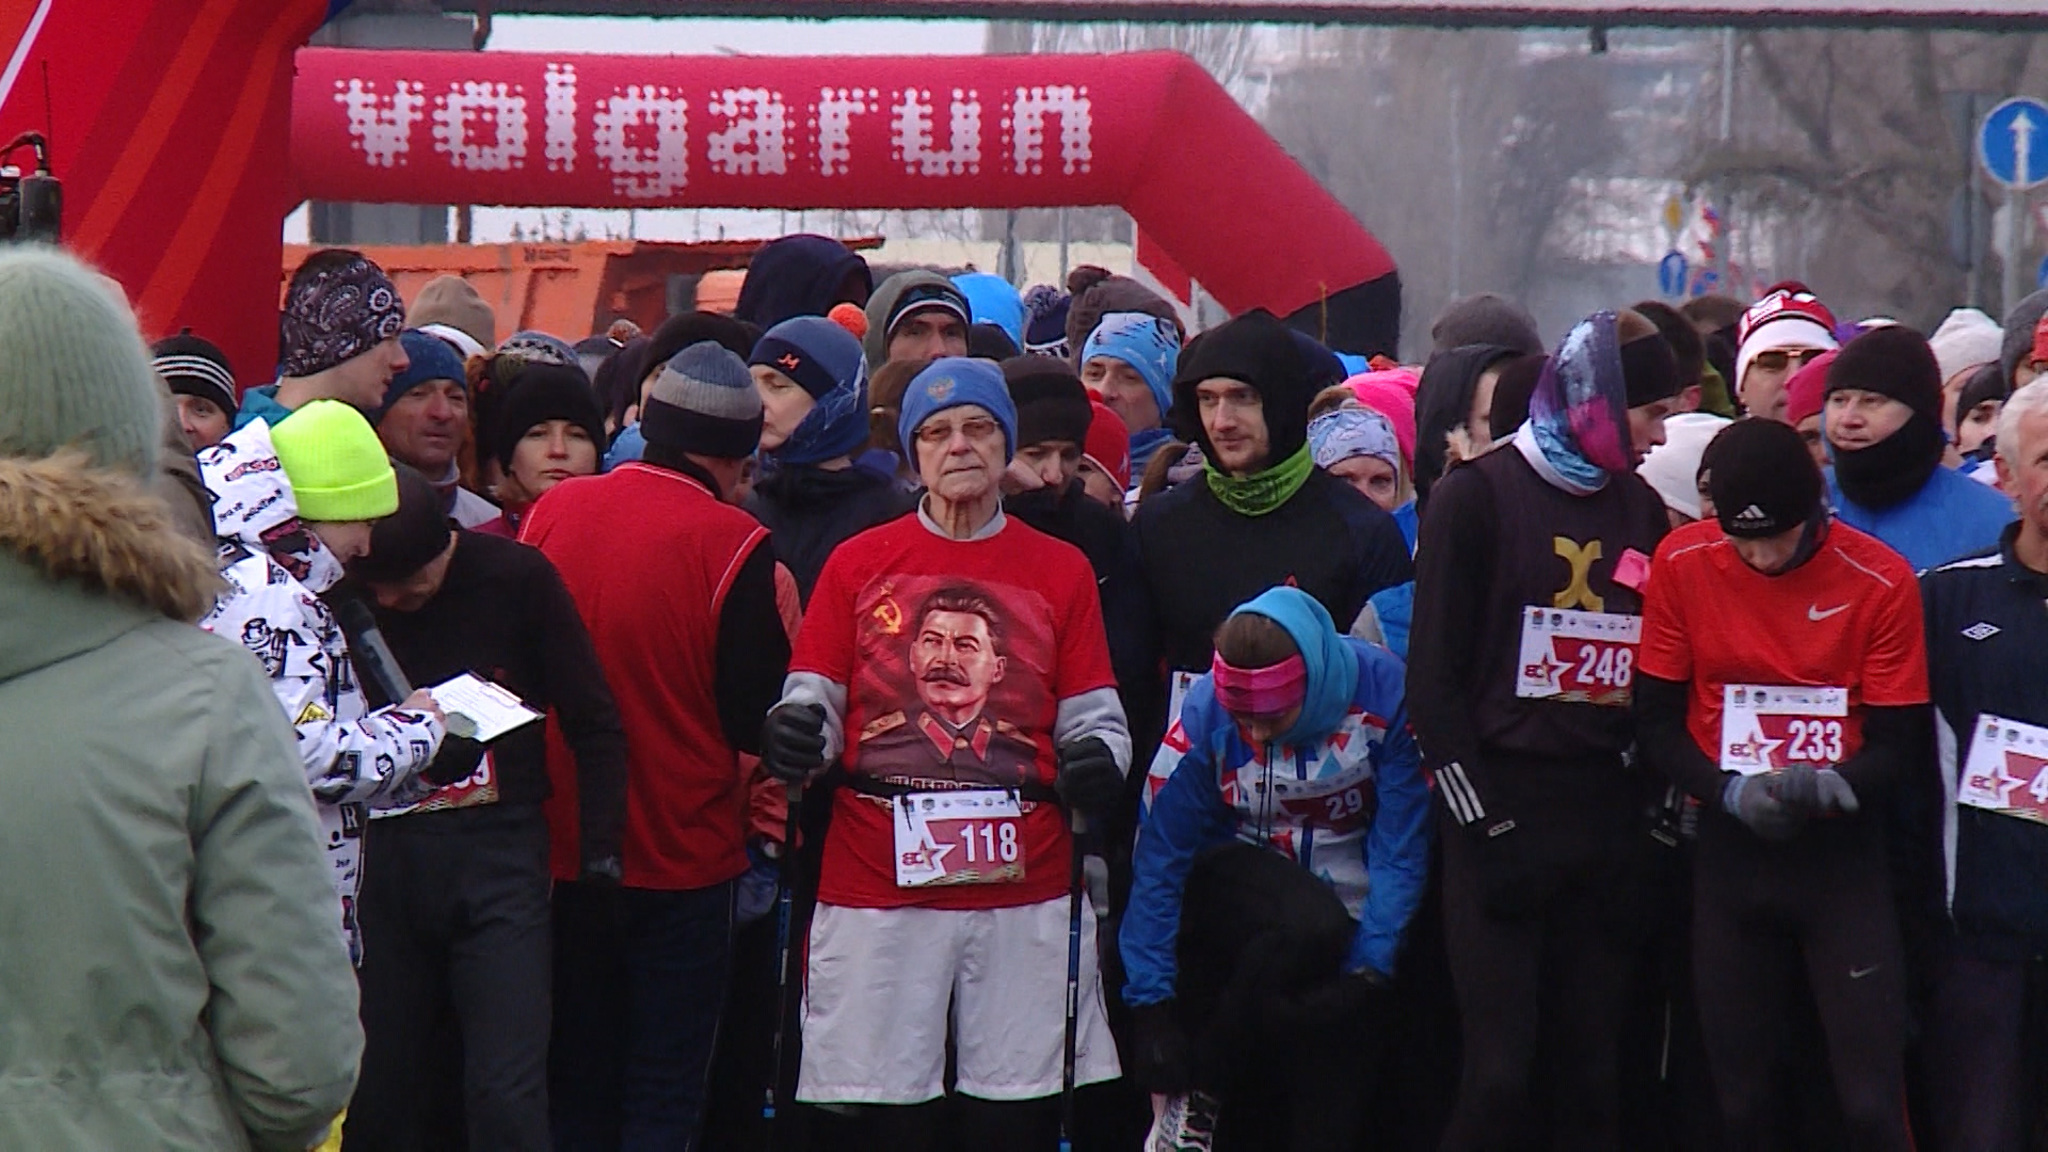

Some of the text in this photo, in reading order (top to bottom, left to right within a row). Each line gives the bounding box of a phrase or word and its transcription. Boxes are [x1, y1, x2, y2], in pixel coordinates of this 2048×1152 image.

[334, 62, 1093, 199] volgarun
[1577, 644, 1633, 688] 248
[1787, 720, 1842, 762] 233
[1325, 788, 1363, 821] 29
[960, 822, 1018, 863] 118
